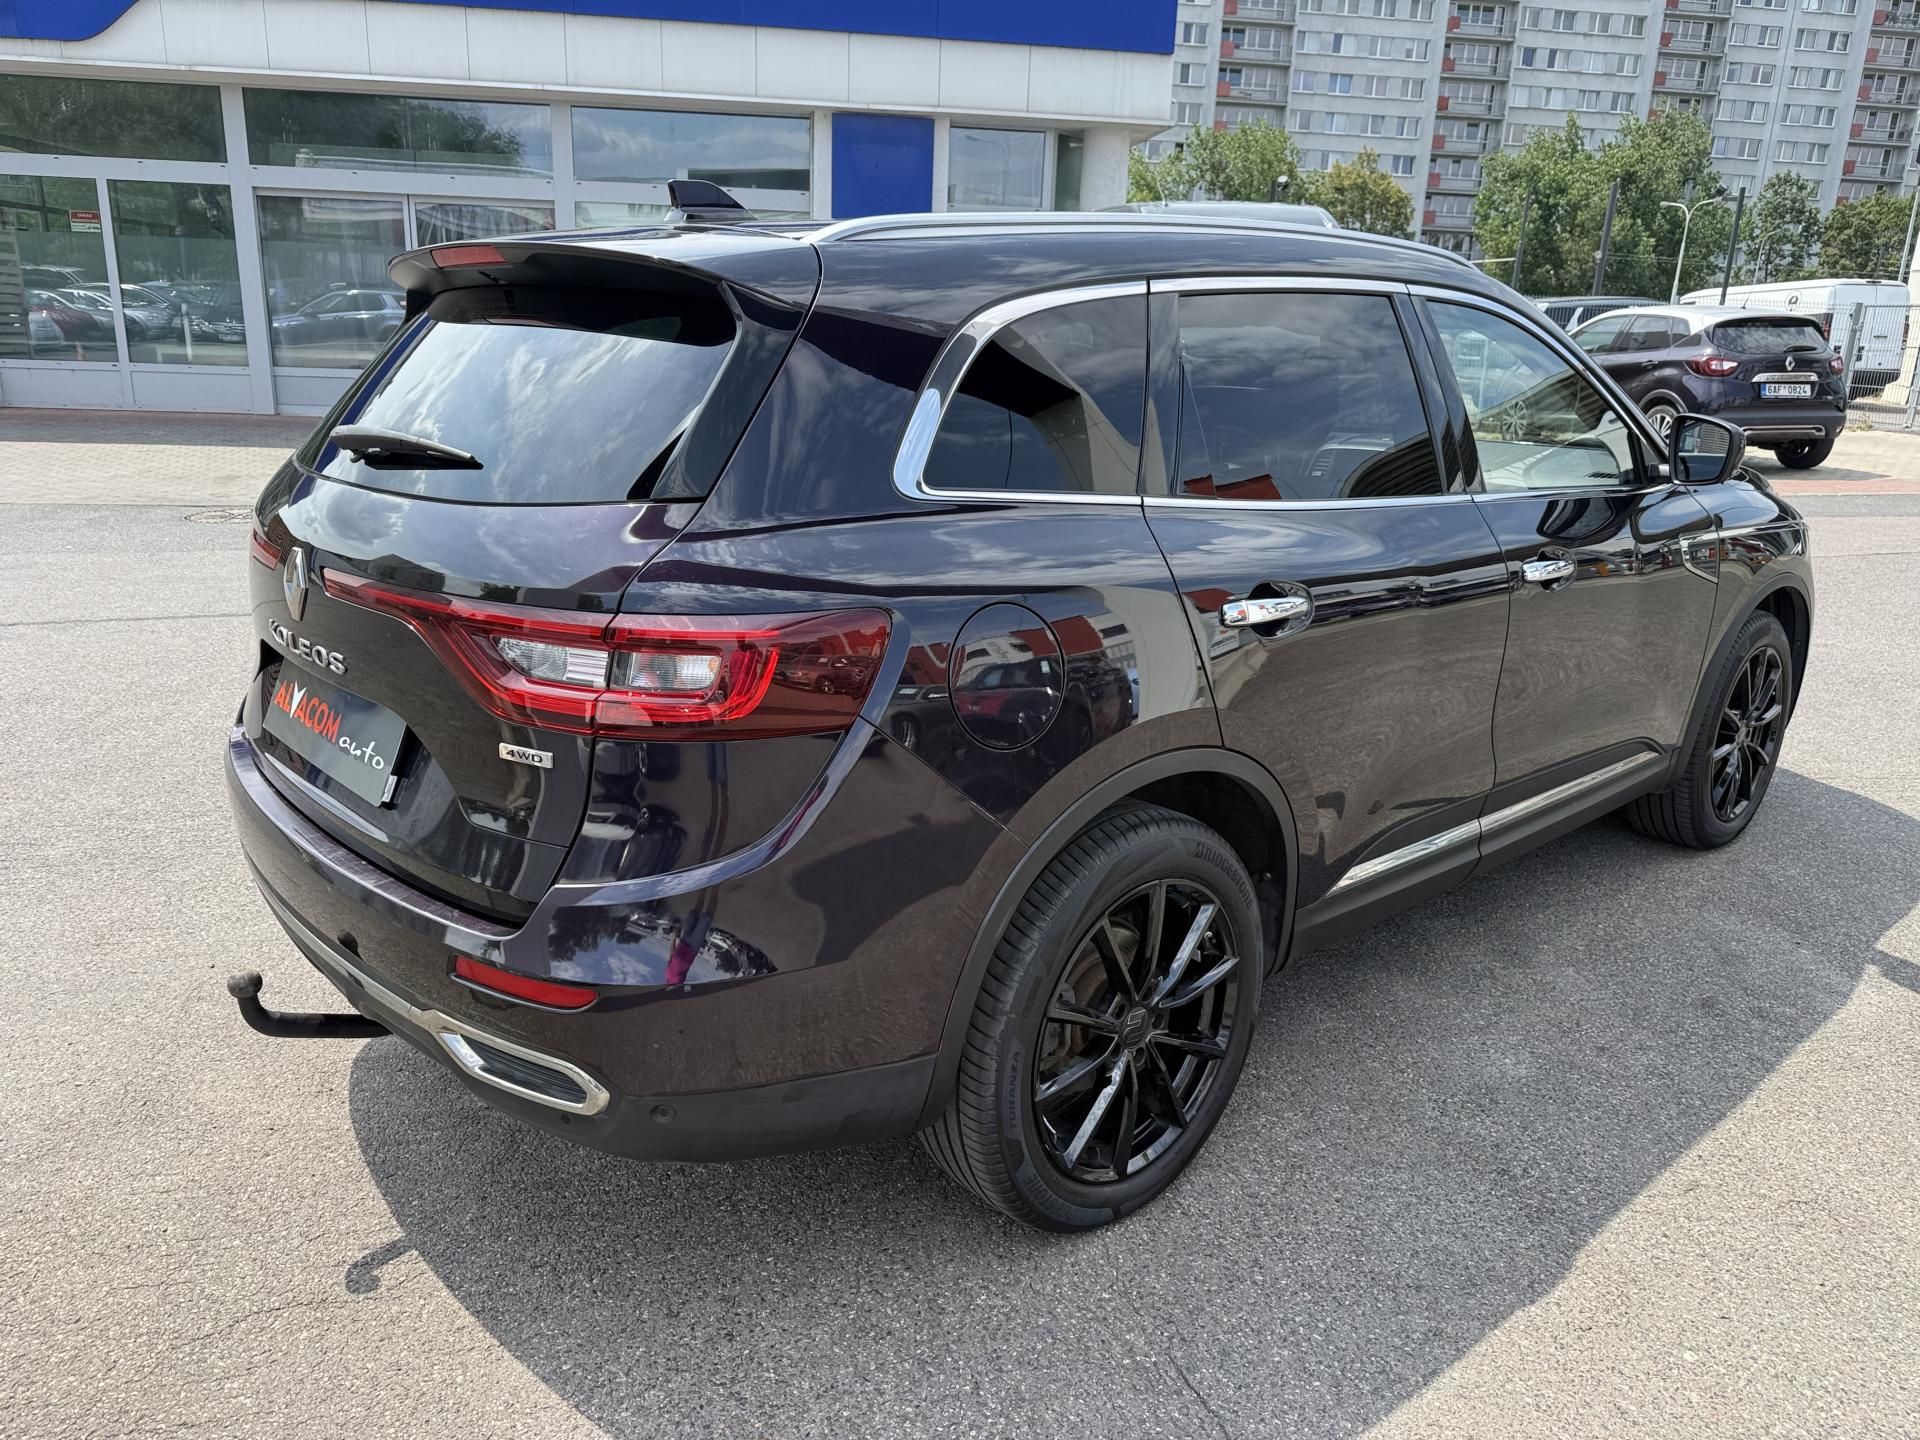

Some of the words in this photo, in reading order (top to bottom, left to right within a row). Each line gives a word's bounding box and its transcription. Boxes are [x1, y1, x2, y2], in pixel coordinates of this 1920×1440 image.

[1768, 386, 1782, 394] 6AF
[1788, 386, 1807, 394] 0824
[268, 618, 347, 675] KOLEOS
[338, 735, 385, 770] auto
[505, 749, 543, 763] 4WD
[1192, 842, 1254, 910] BRIDGESTONE
[1009, 1051, 1020, 1132] TURANZA
[1022, 1172, 1105, 1224] RIDGESTONE
